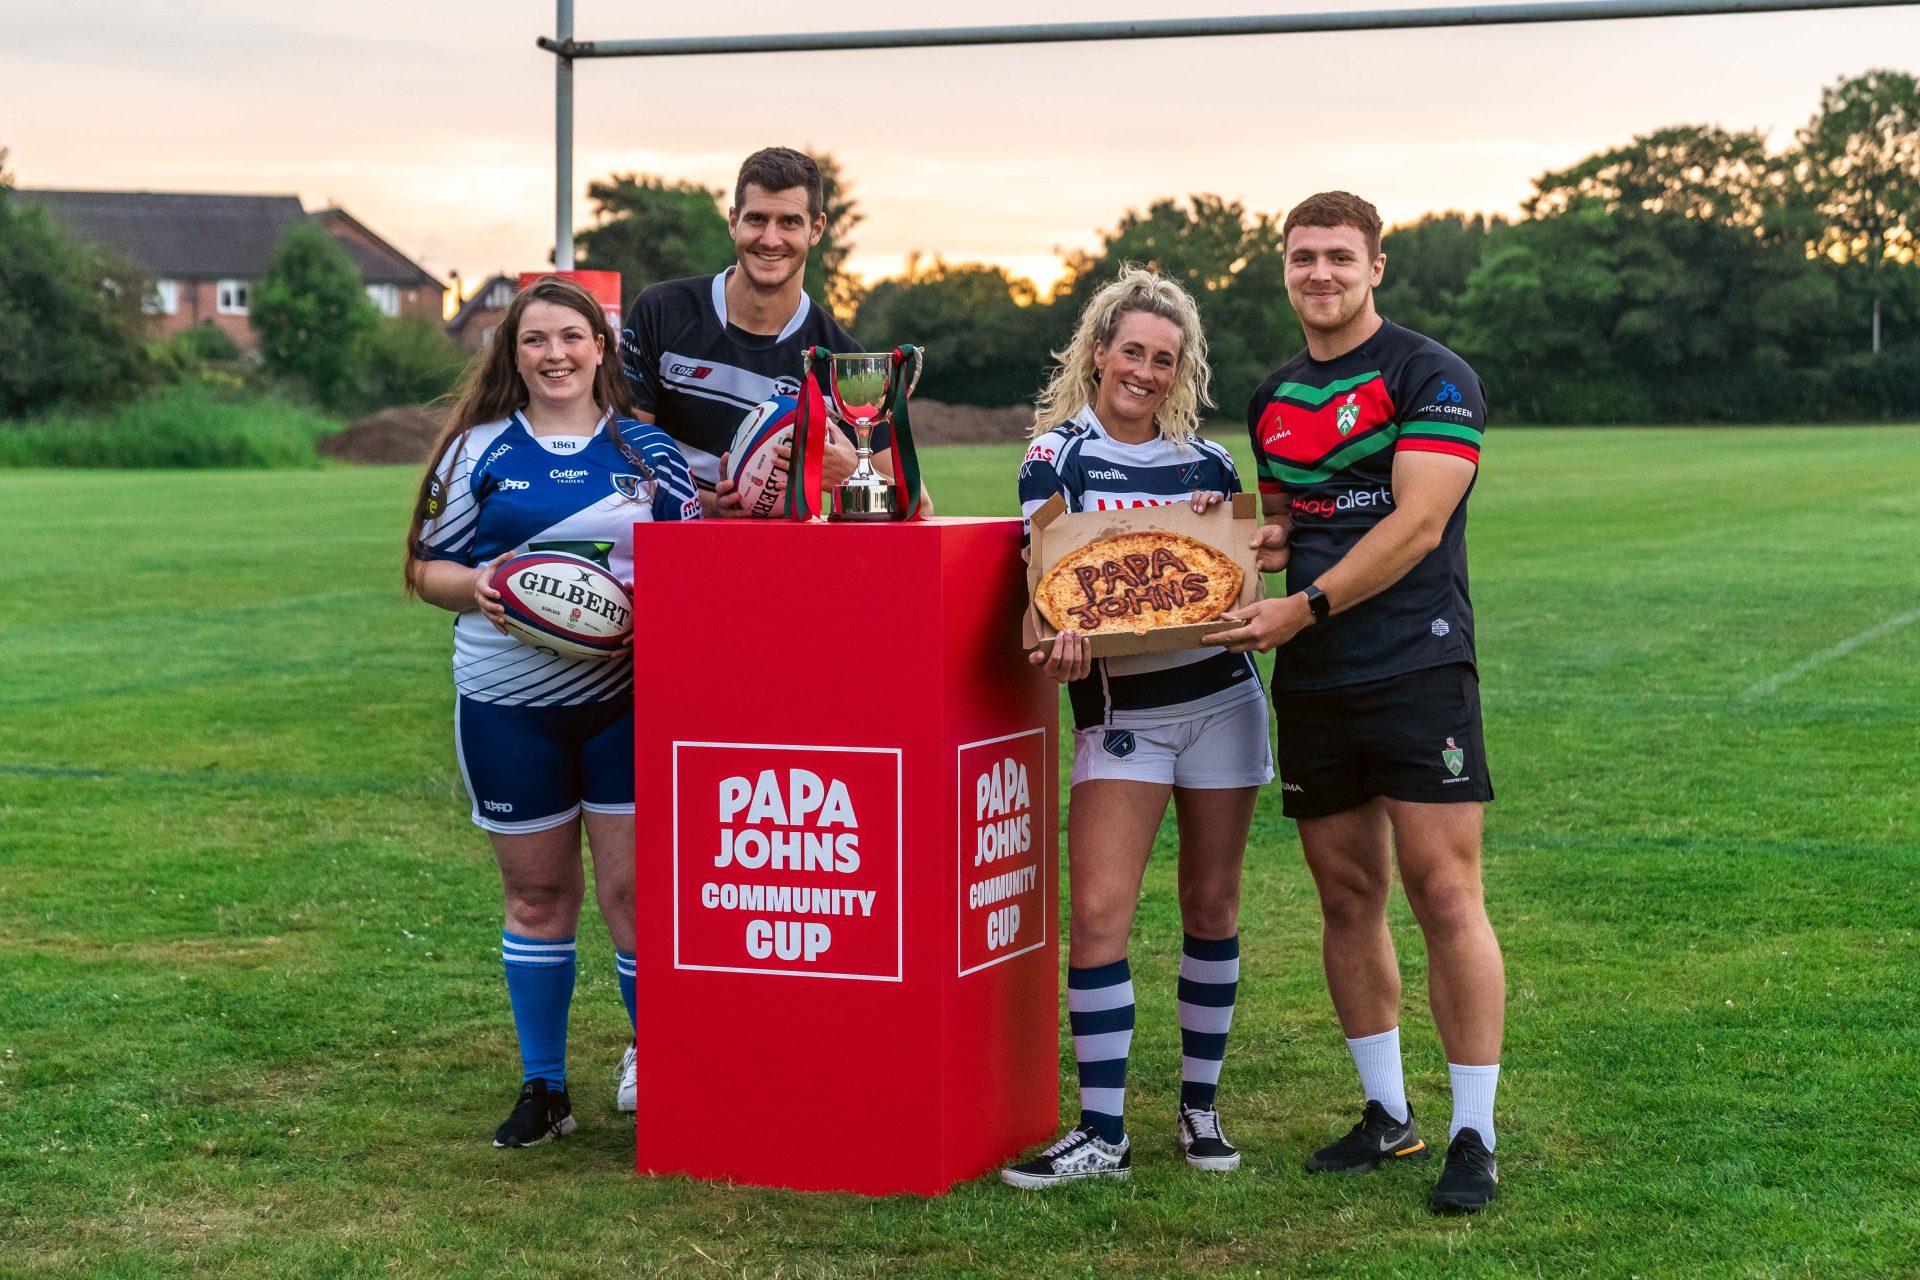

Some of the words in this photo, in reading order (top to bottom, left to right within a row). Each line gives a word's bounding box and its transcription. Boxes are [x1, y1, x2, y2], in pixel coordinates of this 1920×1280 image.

[1444, 405, 1472, 418] GREEN
[551, 441, 576, 449] 1861
[1265, 429, 1291, 445] AKUMA
[549, 469, 589, 479] Cotton
[1074, 547, 1188, 600] PAPA
[519, 571, 630, 627] GILBERT
[1067, 573, 1209, 630] JOHNS
[719, 768, 859, 828] PAPA
[977, 757, 1031, 822] PAPA
[714, 828, 861, 874] JOHNS
[974, 813, 1031, 867] JOHNS
[701, 882, 876, 917] COMMUNITY
[969, 864, 1037, 910] COMMUNITY
[746, 919, 832, 962] CUP
[987, 903, 1021, 951] CUP
